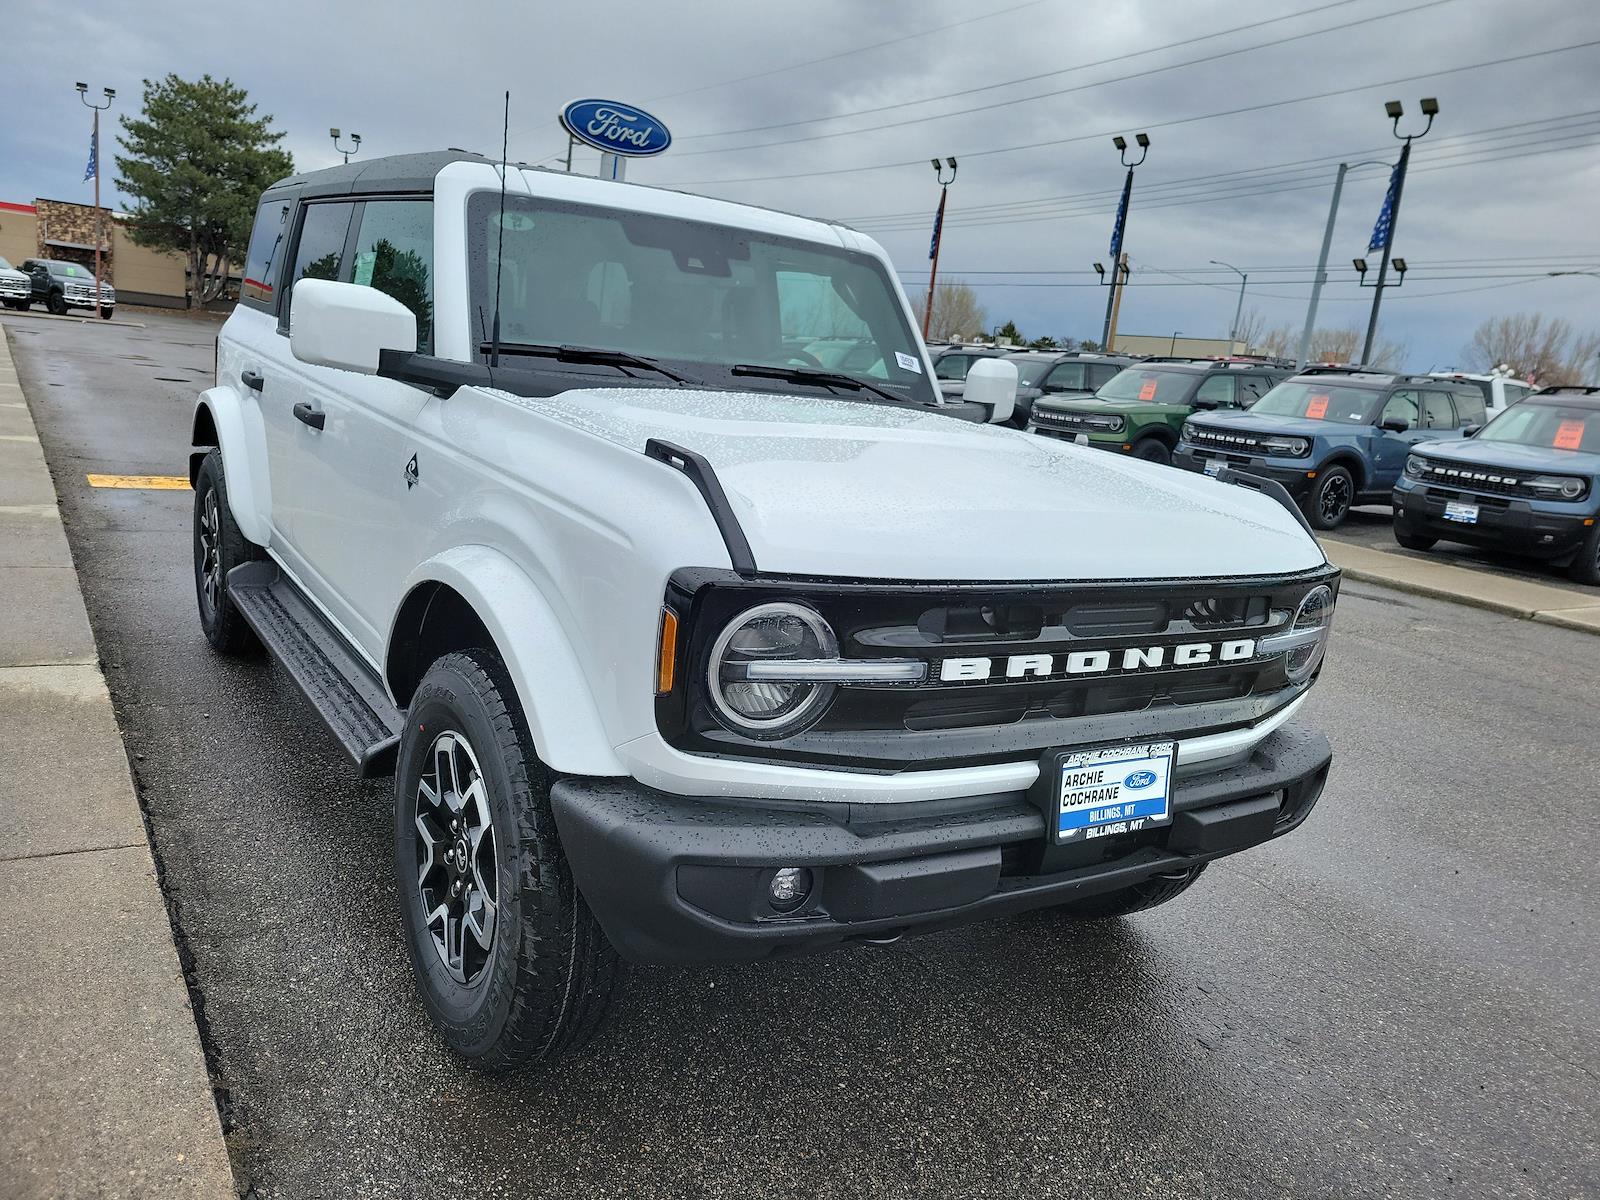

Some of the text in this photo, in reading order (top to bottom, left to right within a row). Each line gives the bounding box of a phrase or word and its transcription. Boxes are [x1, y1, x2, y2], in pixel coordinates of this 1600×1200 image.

[587, 107, 653, 147] Ford
[1198, 432, 1257, 446] BRONCO
[1433, 467, 1518, 485] BRONCO
[940, 639, 1256, 681] BRONCO
[1100, 745, 1150, 757] COCHRANE
[1149, 742, 1174, 753] FORD
[1064, 770, 1104, 788] ARCHIE
[1129, 771, 1151, 787] Ford
[1062, 786, 1120, 807] COCHRANE
[1089, 804, 1136, 823] BILLINGS, MT
[1086, 819, 1145, 839] BILLINGS, MT
